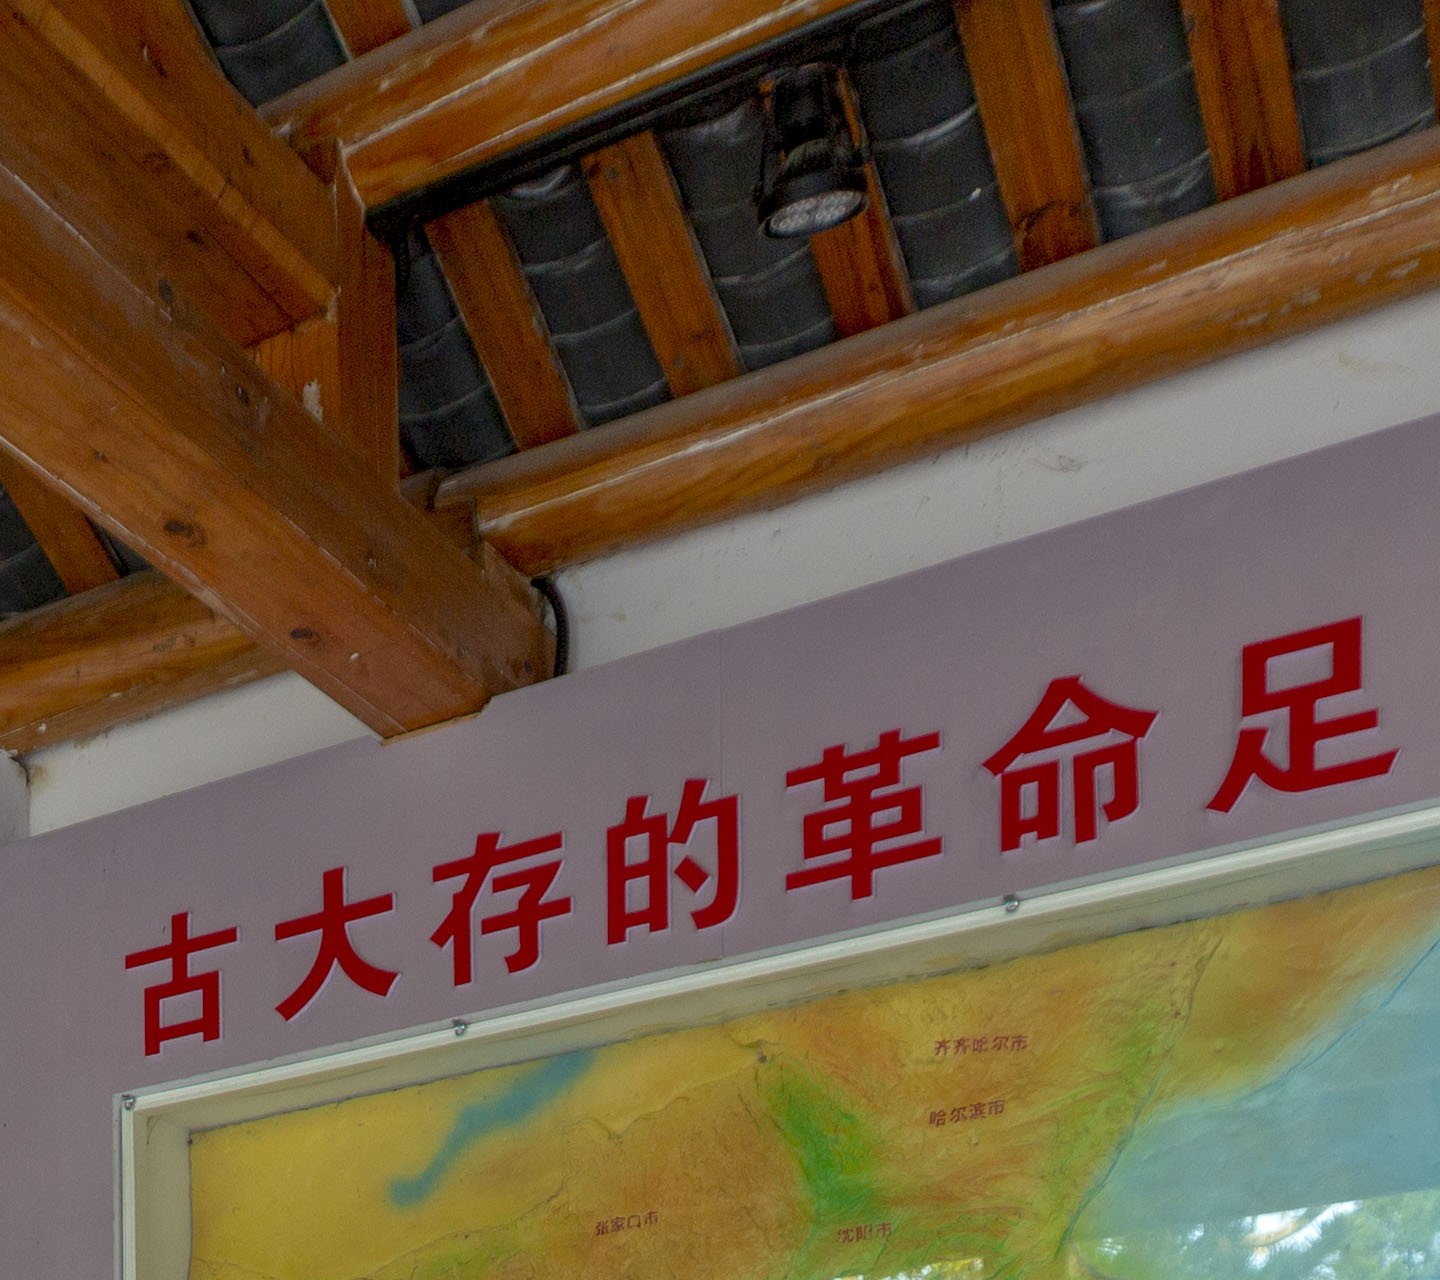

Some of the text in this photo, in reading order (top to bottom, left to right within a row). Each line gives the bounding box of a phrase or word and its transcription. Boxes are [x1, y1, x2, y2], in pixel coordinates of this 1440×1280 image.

[928, 1099, 1005, 1127] 哈尔滨市
[595, 1211, 659, 1236] 张家口市
[837, 1222, 892, 1243] 沈阳市
